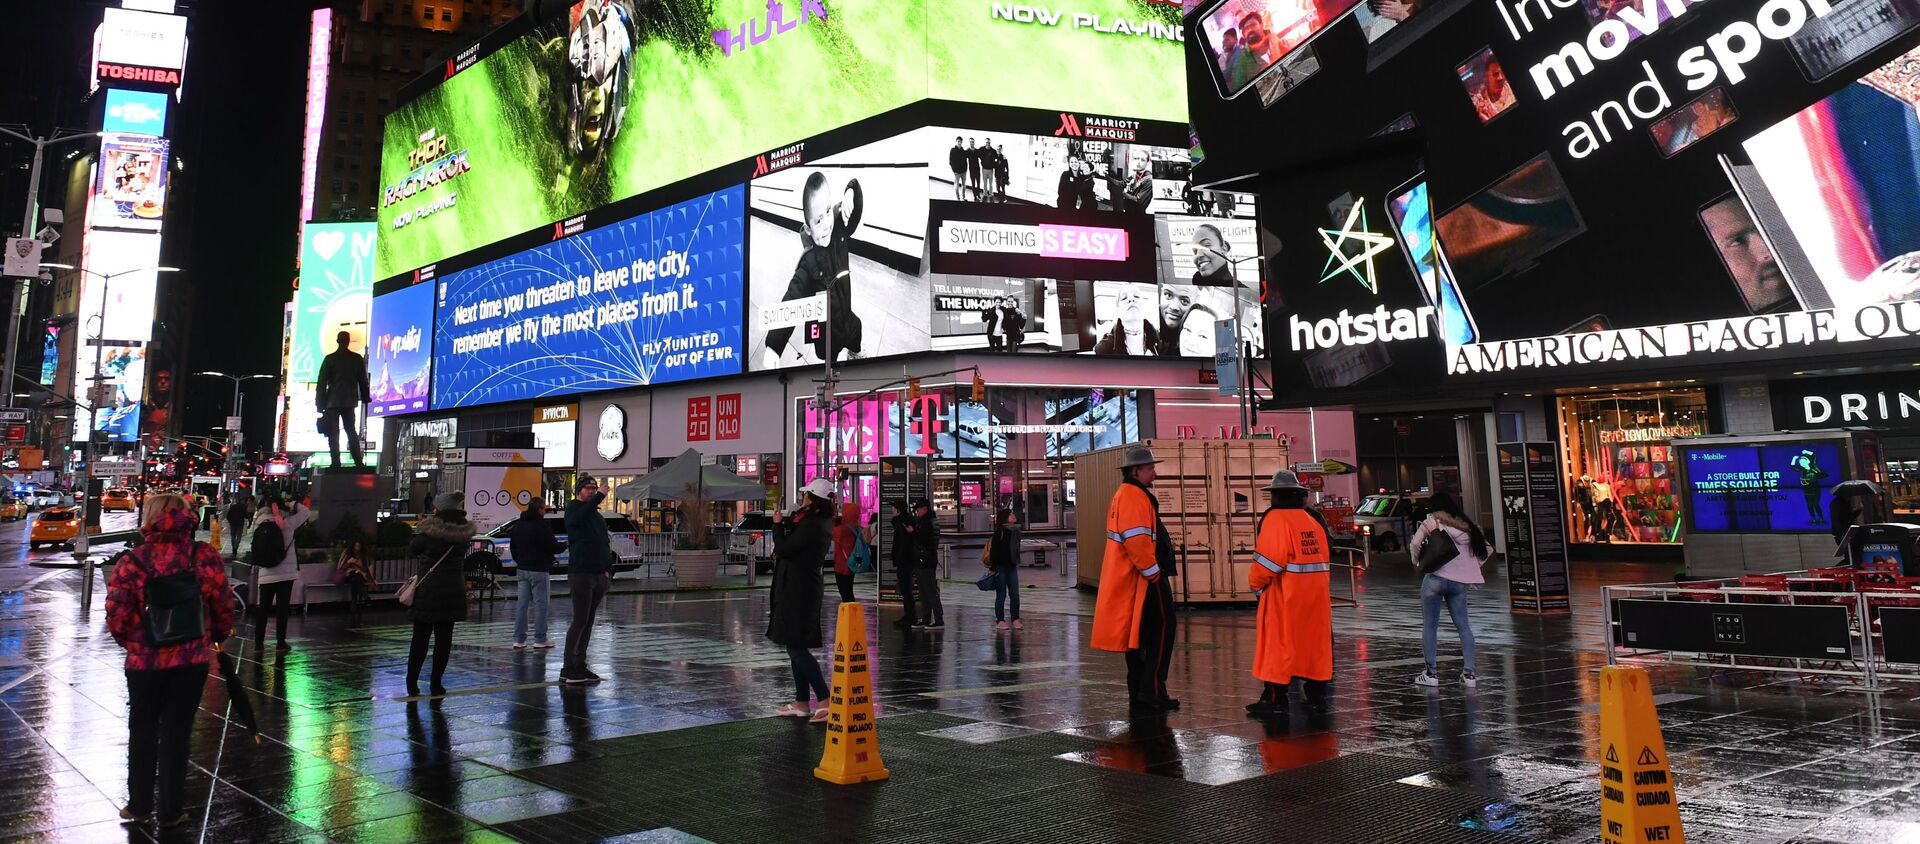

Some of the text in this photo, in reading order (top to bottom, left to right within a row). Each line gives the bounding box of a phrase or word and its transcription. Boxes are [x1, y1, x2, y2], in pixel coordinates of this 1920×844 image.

[992, 1, 1062, 26] NOW
[711, 0, 829, 58] HULK
[98, 64, 178, 84] TOSHIBA
[308, 69, 325, 129] Served
[1562, 60, 1672, 159] and
[1086, 116, 1140, 130] MARRIOTT
[1086, 127, 1134, 140] MARQUIS
[408, 135, 446, 170] THOR
[770, 143, 804, 160] MARRIOTT
[770, 154, 801, 170] MARQUIS
[392, 192, 457, 230] NOW PLAYING
[564, 214, 587, 227] MARRIOTT
[950, 228, 1036, 248] SWITCHING
[1062, 230, 1120, 256] EASY
[454, 250, 690, 326] Next time you threaten to leave the city,
[934, 284, 952, 293] TELL
[952, 286, 962, 294] US
[962, 286, 978, 294] WHY
[940, 298, 962, 309] THE
[452, 328, 504, 354] remember
[506, 324, 522, 344] we
[523, 317, 539, 344] fly
[541, 314, 560, 338] the
[562, 304, 594, 333] most
[596, 299, 638, 330] places
[642, 290, 678, 318] from
[682, 283, 698, 310] it.
[763, 301, 823, 325] SWITCHING IS
[1290, 304, 1434, 351] hotstar
[642, 332, 719, 356] FLY UNITED
[1454, 326, 1668, 373] AMERICAN
[1684, 309, 1838, 352] EAGLE
[666, 346, 732, 368] OUT OF EWR
[690, 402, 708, 418] ユニ
[718, 400, 736, 416] UNI
[1804, 390, 1920, 424] DRIN
[689, 421, 707, 436] クロ
[718, 420, 738, 437] QLO
[1695, 480, 1778, 493] TIMES SQUARE
[852, 686, 864, 694] WET
[849, 696, 868, 705] FLOOR
[853, 713, 866, 722] PISO
[828, 723, 843, 733] MOJADO
[848, 722, 872, 734] MOJADO
[1603, 765, 1622, 784] CAUTION
[1634, 770, 1667, 786] CAUTION
[1604, 786, 1624, 804] CUIDADO
[1636, 791, 1670, 806] CUIDADO
[1607, 819, 1622, 837] WET
[1644, 826, 1670, 842] WET
